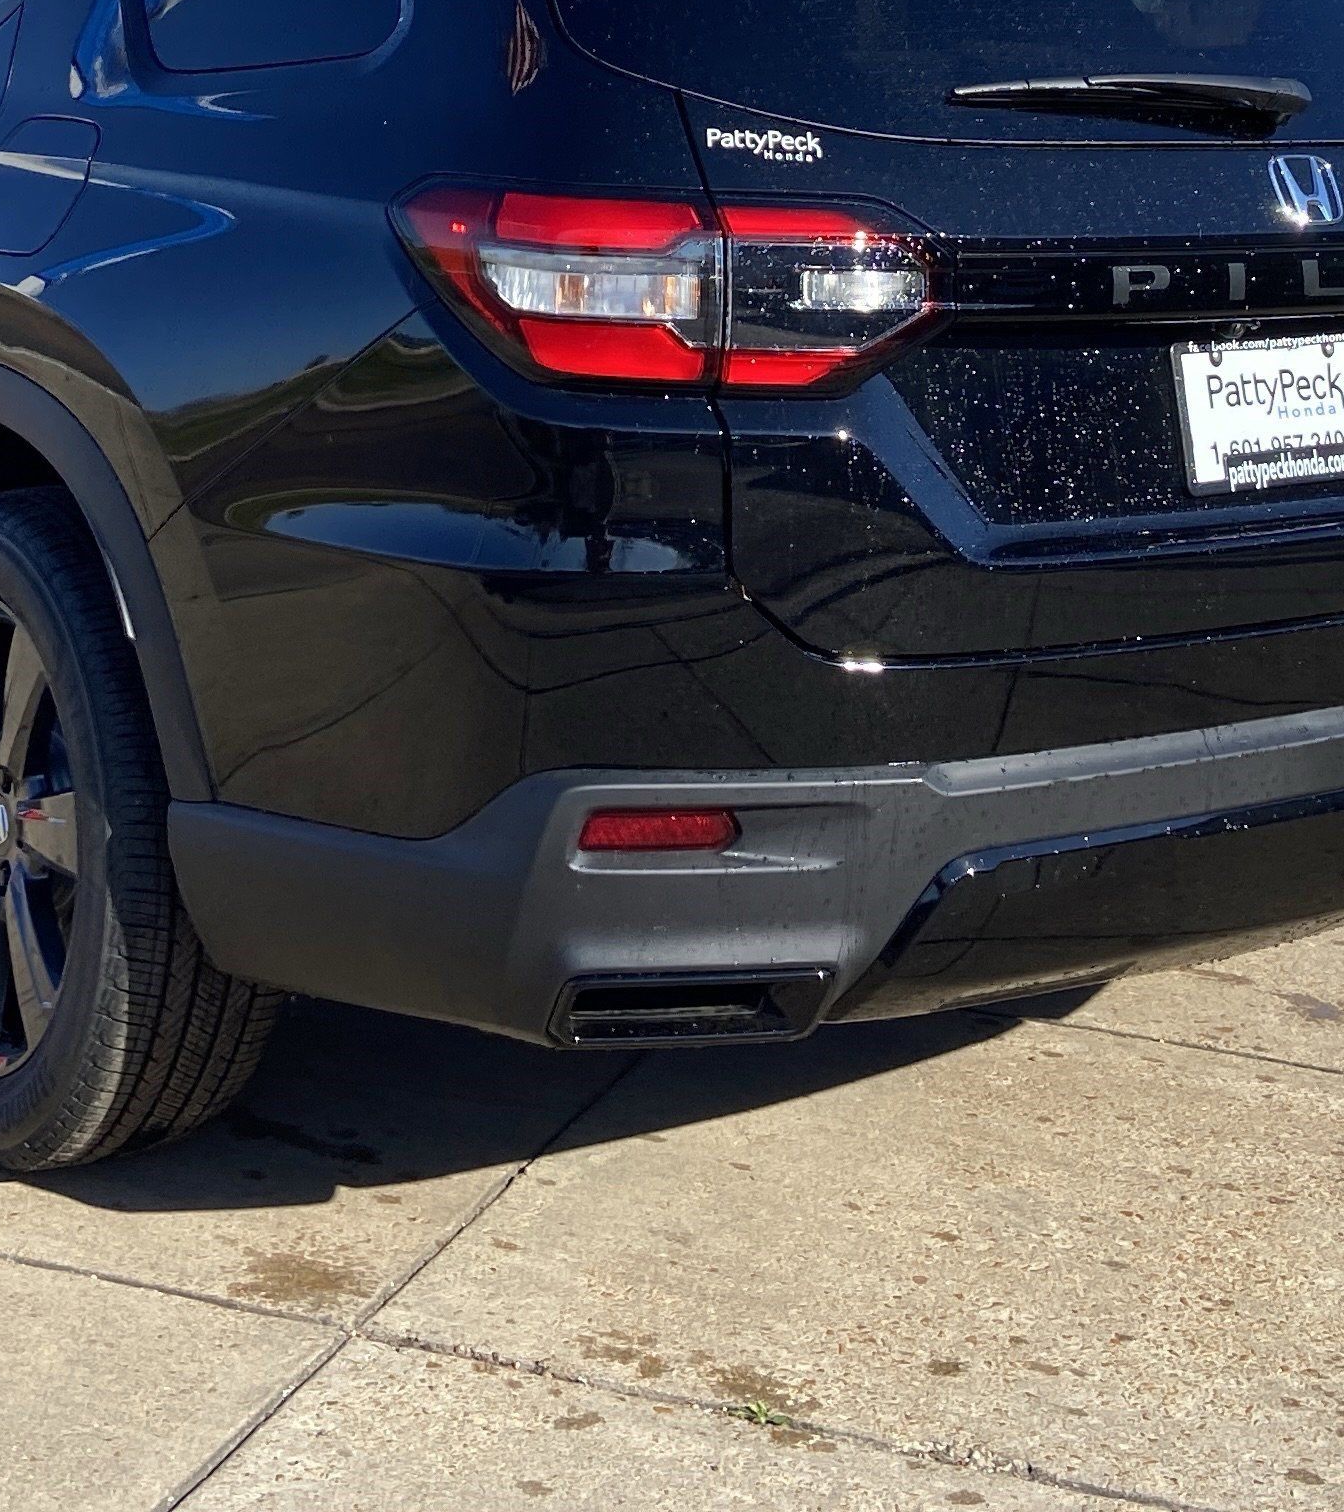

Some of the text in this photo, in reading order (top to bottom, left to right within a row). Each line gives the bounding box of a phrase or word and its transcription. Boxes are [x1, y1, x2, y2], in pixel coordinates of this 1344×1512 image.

[706, 128, 824, 158] PattyPeck
[763, 149, 813, 162] Honda
[1277, 403, 1337, 419] Honda
